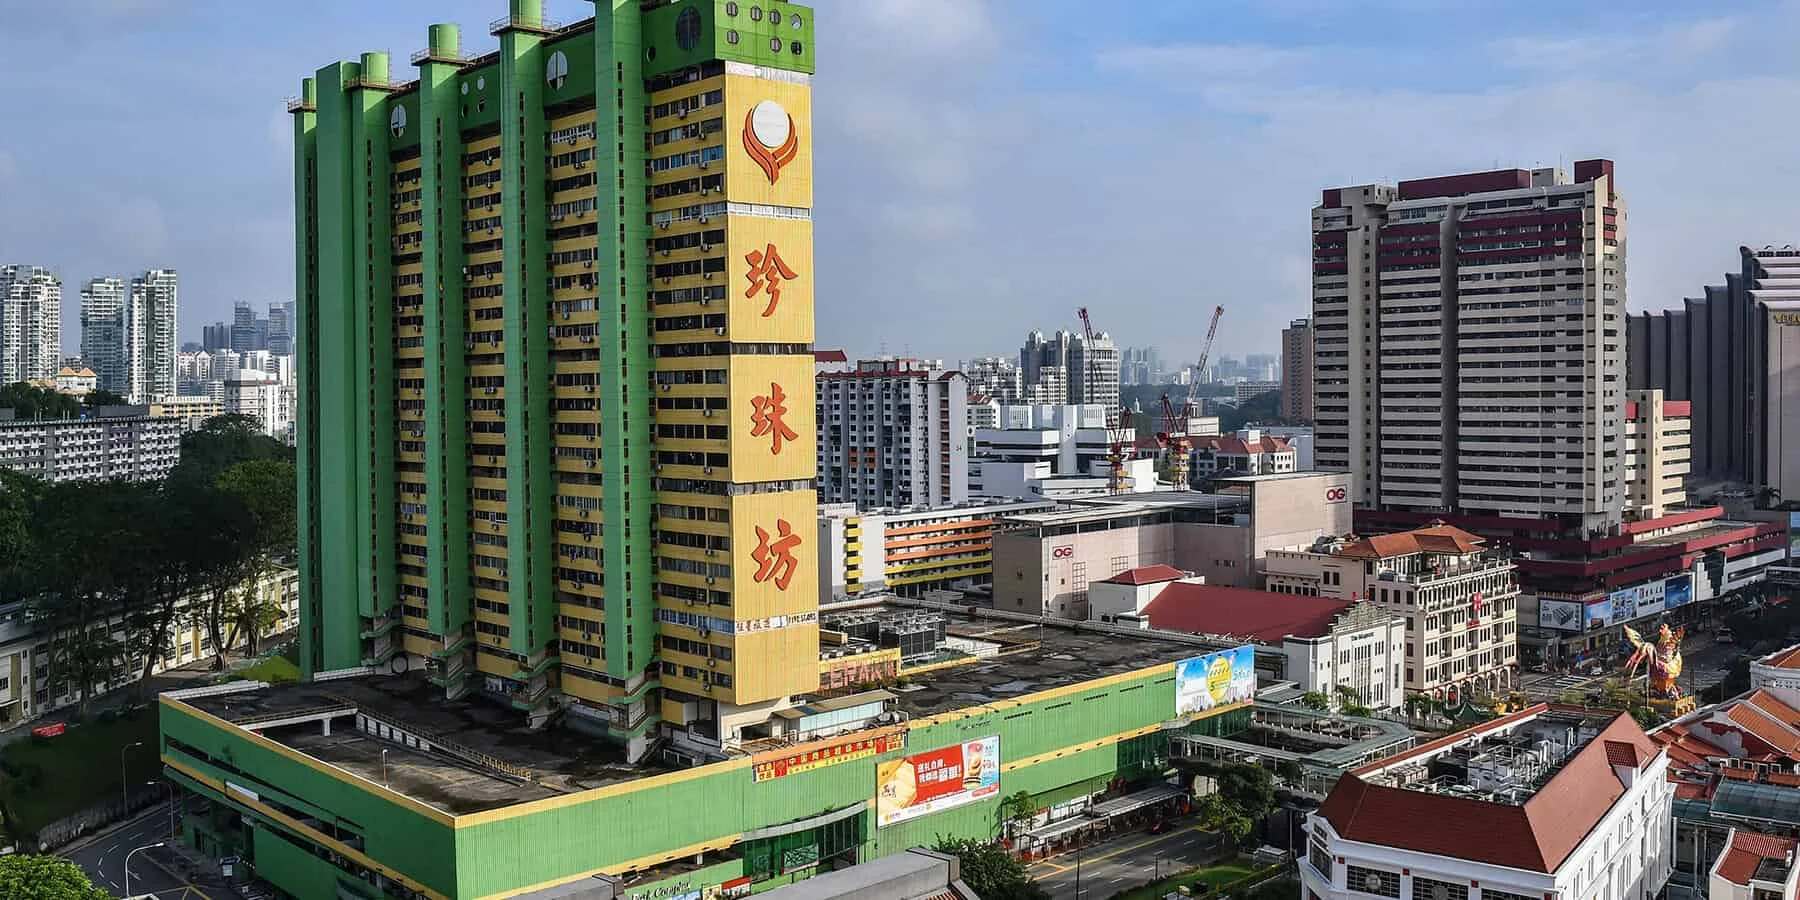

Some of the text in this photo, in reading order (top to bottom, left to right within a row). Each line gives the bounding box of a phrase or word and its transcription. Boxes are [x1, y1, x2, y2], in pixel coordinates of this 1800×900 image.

[745, 243, 802, 592] 珍珠坊
[1326, 487, 1345, 501] OG
[1053, 547, 1073, 558] OG
